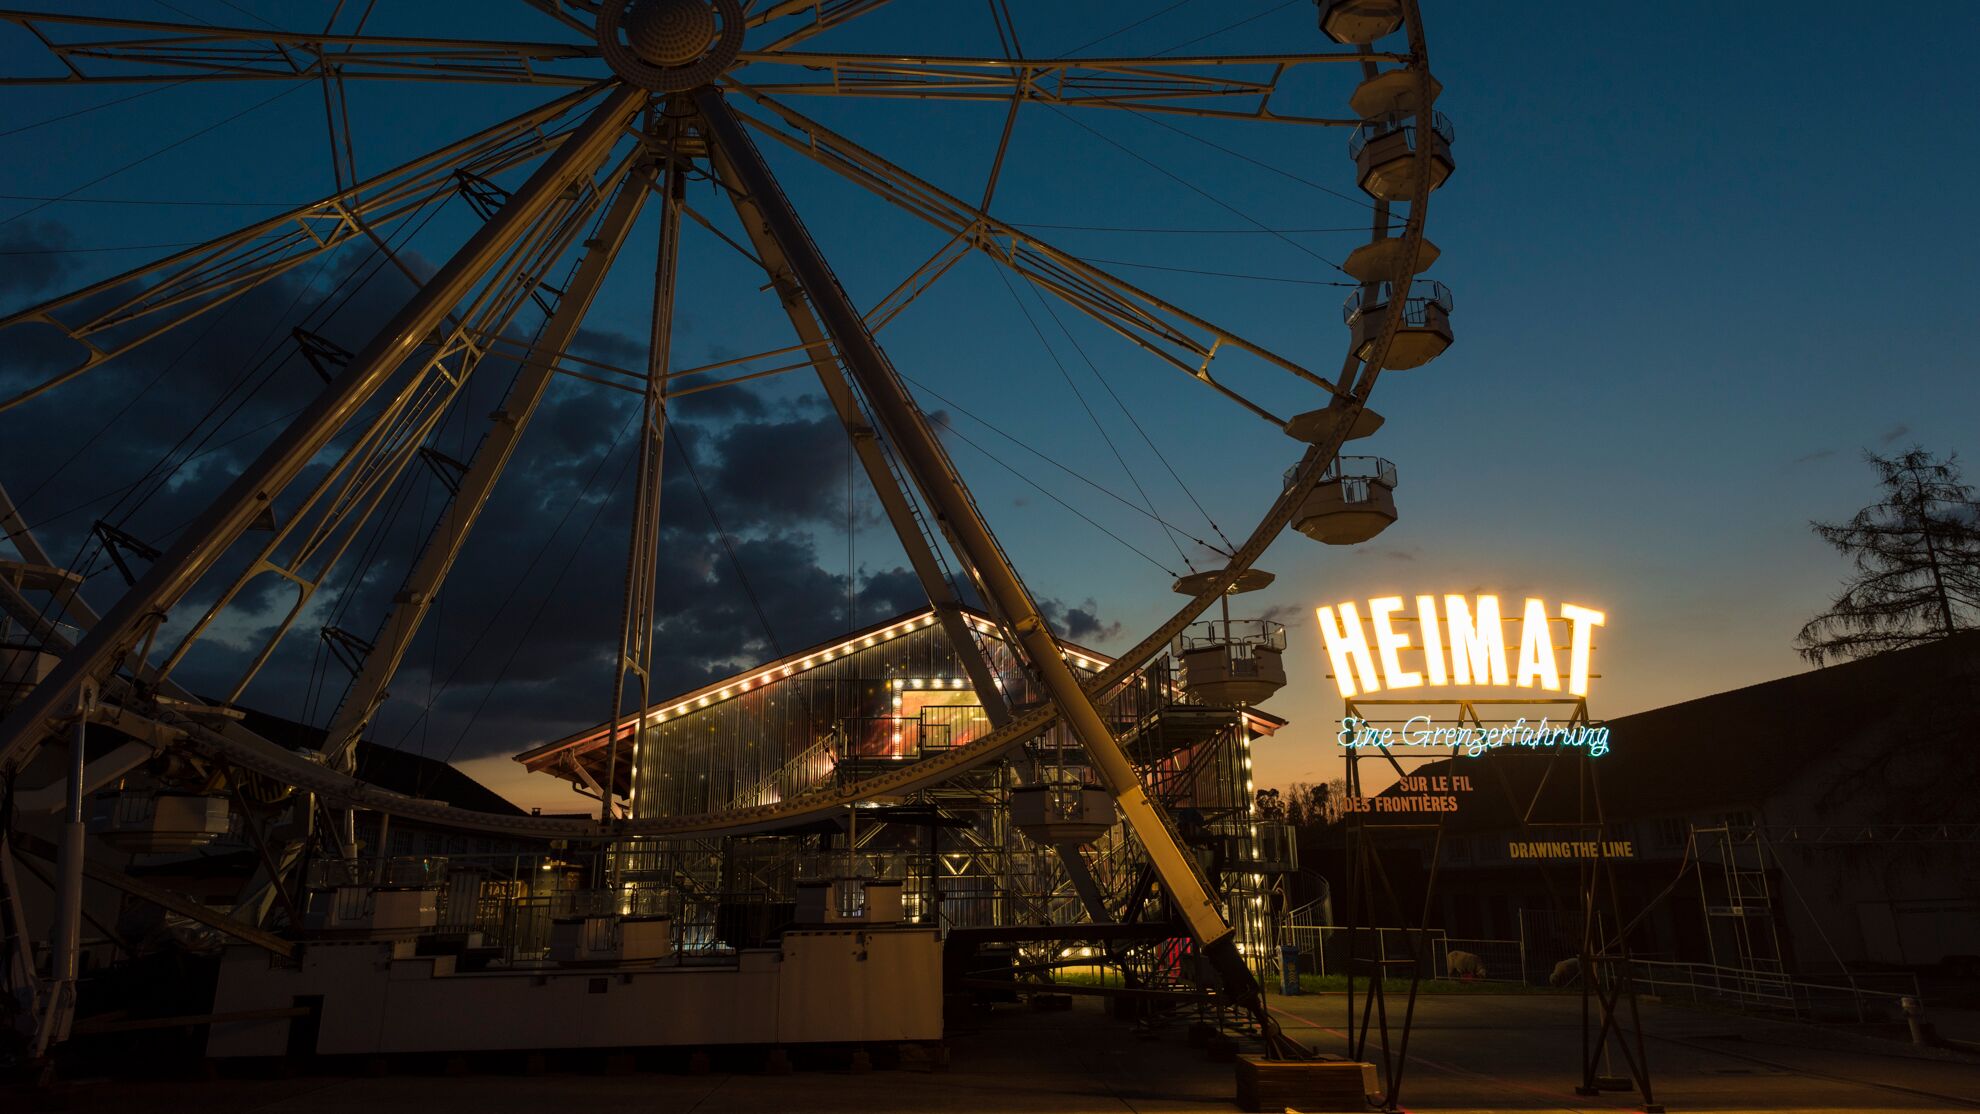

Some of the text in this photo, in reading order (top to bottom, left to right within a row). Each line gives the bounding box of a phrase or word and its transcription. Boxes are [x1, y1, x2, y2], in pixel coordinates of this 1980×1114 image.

[1316, 593, 1606, 698] HEIMAT
[1337, 715, 1610, 757] Eine Grenzerfahrung
[1400, 775, 1474, 792] SUR LE FIL
[1344, 793, 1458, 812] DES FRONTIÈRES
[1509, 841, 1634, 858] DRAWING THE LINE
